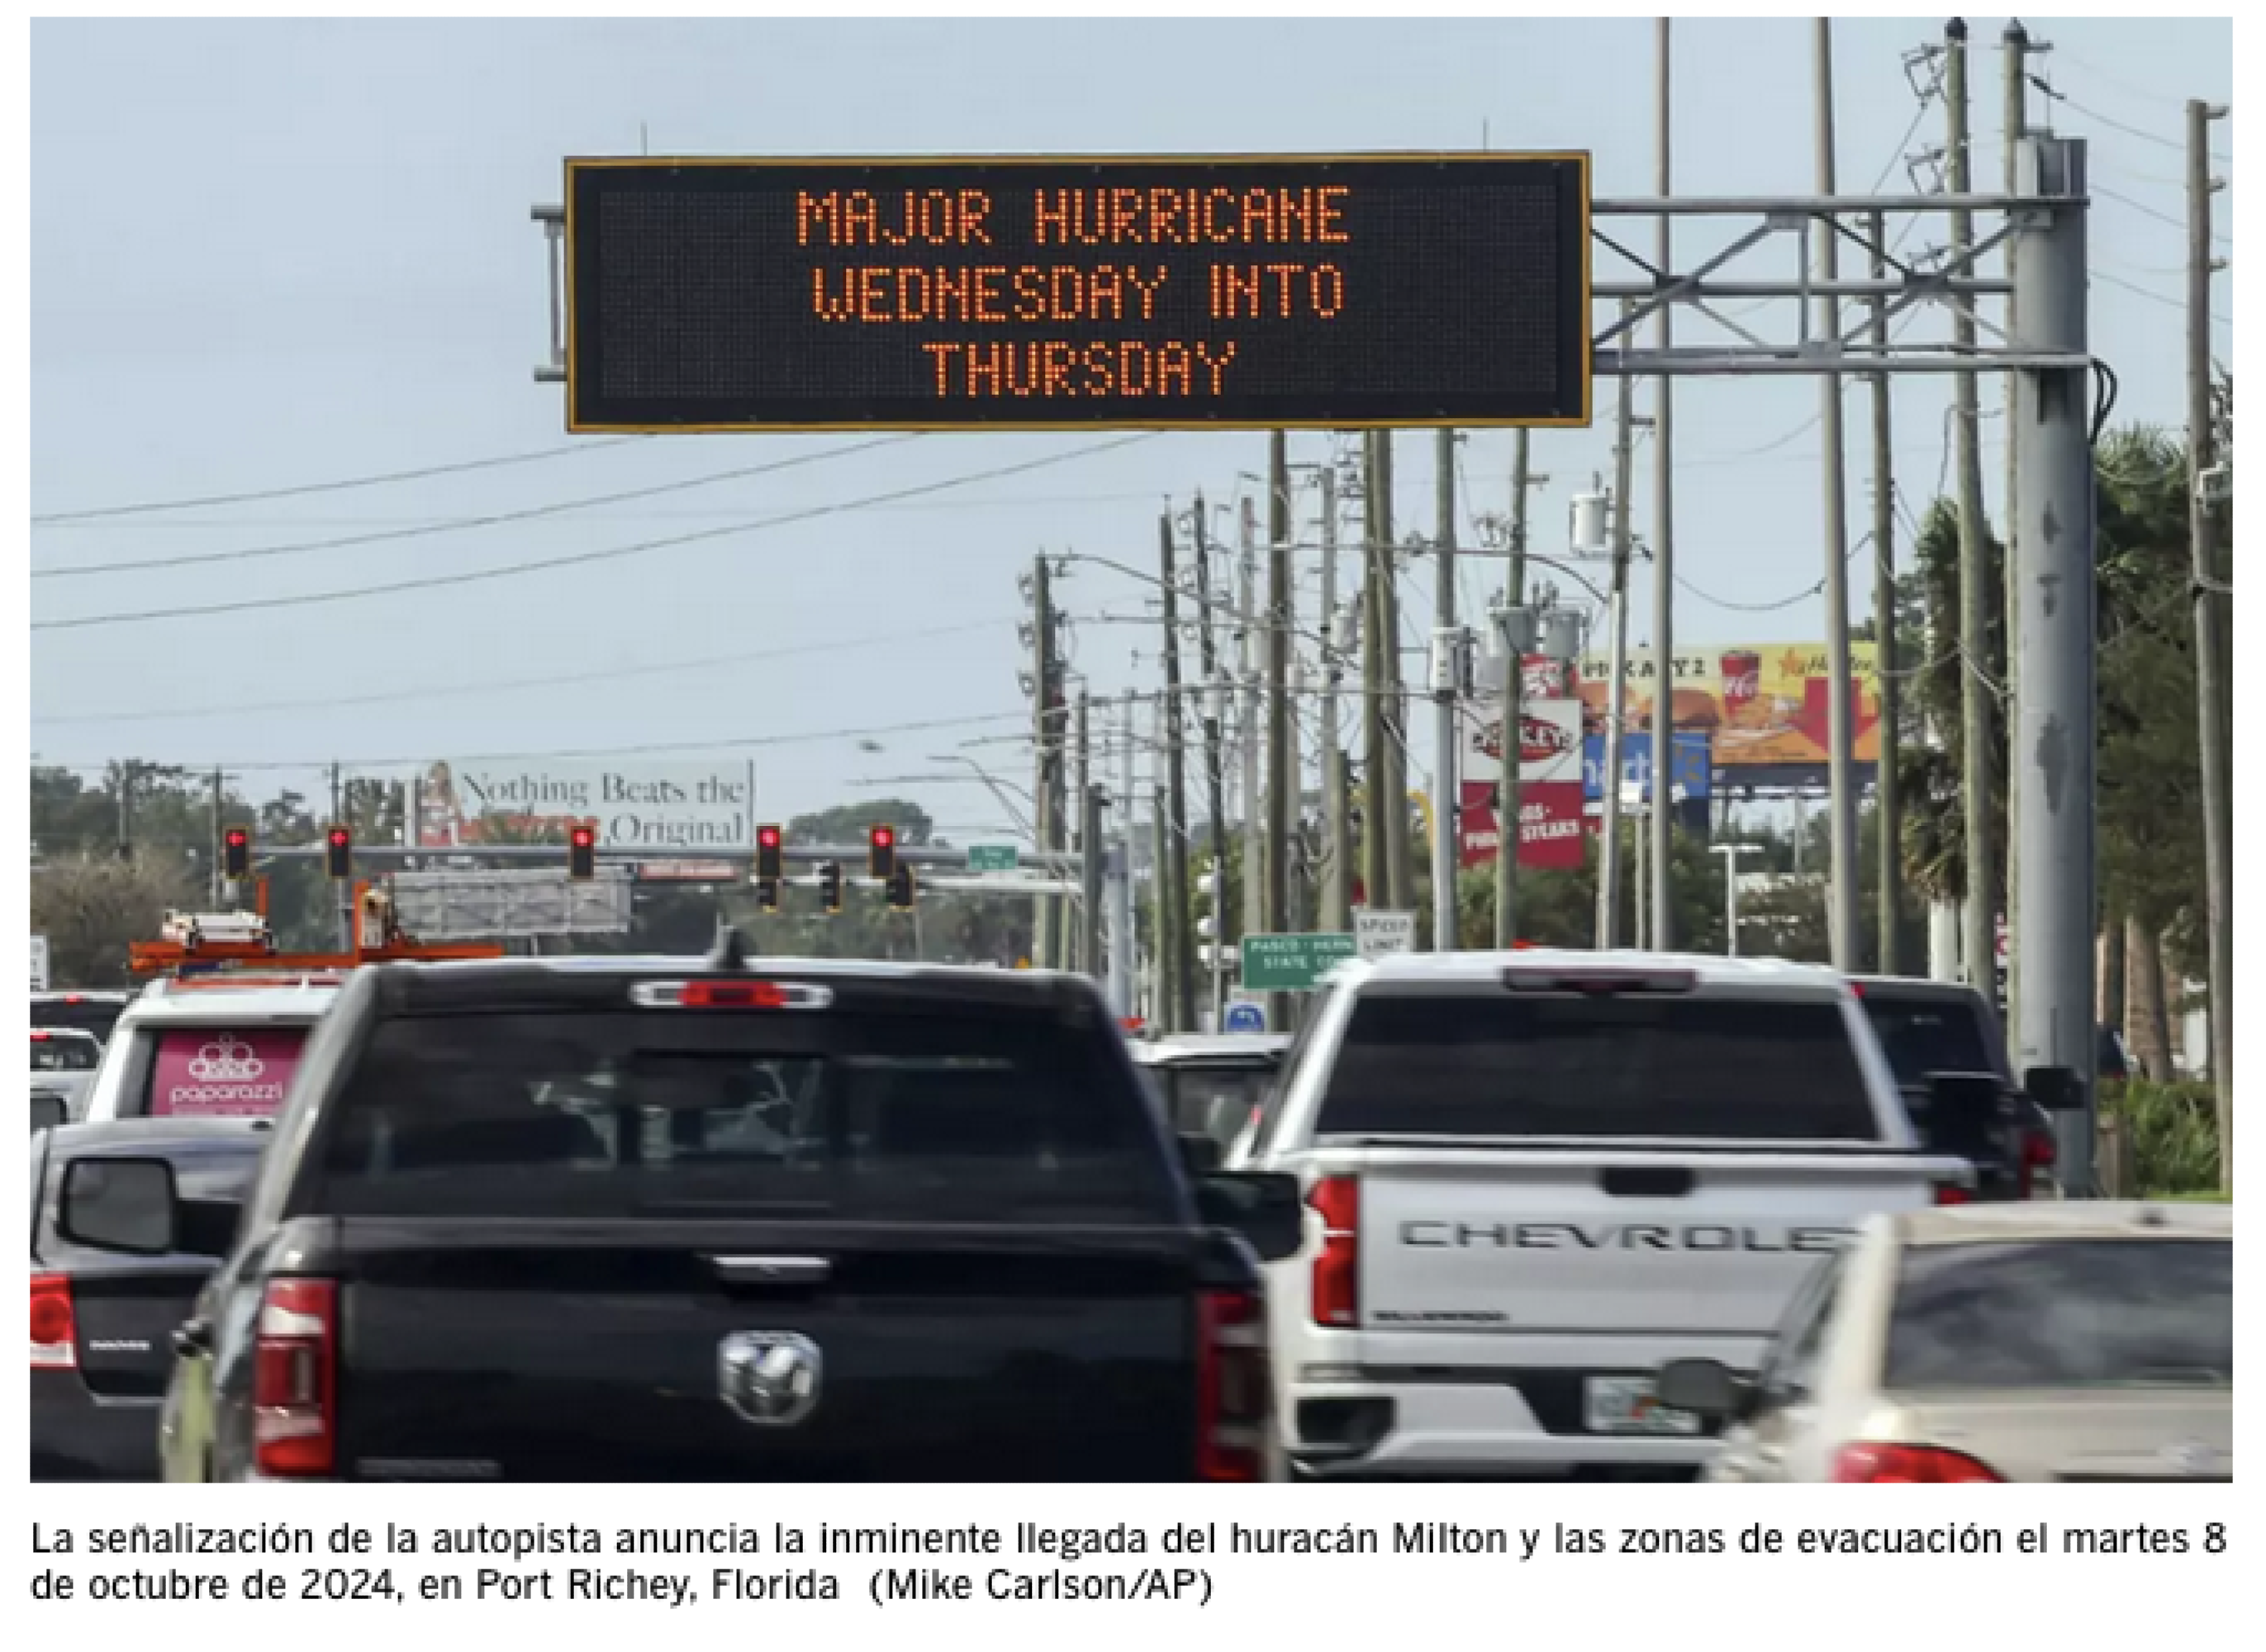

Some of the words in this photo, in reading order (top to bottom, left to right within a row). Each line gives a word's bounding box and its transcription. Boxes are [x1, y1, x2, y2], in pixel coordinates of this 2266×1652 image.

[796, 188, 990, 246] MAJOR
[1034, 185, 1350, 244] HURRICANE
[812, 264, 1168, 322] WEDNESDAY
[1210, 263, 1345, 319] INTO
[922, 341, 1236, 396] THURSDAY
[462, 771, 589, 808] Nothing
[601, 772, 687, 804] Beats
[696, 774, 746, 804] the
[610, 811, 742, 847] Original
[1263, 954, 1309, 970] STATE
[169, 1081, 283, 1106] paparazzi
[1398, 1219, 1862, 1251] CHEVROLE
